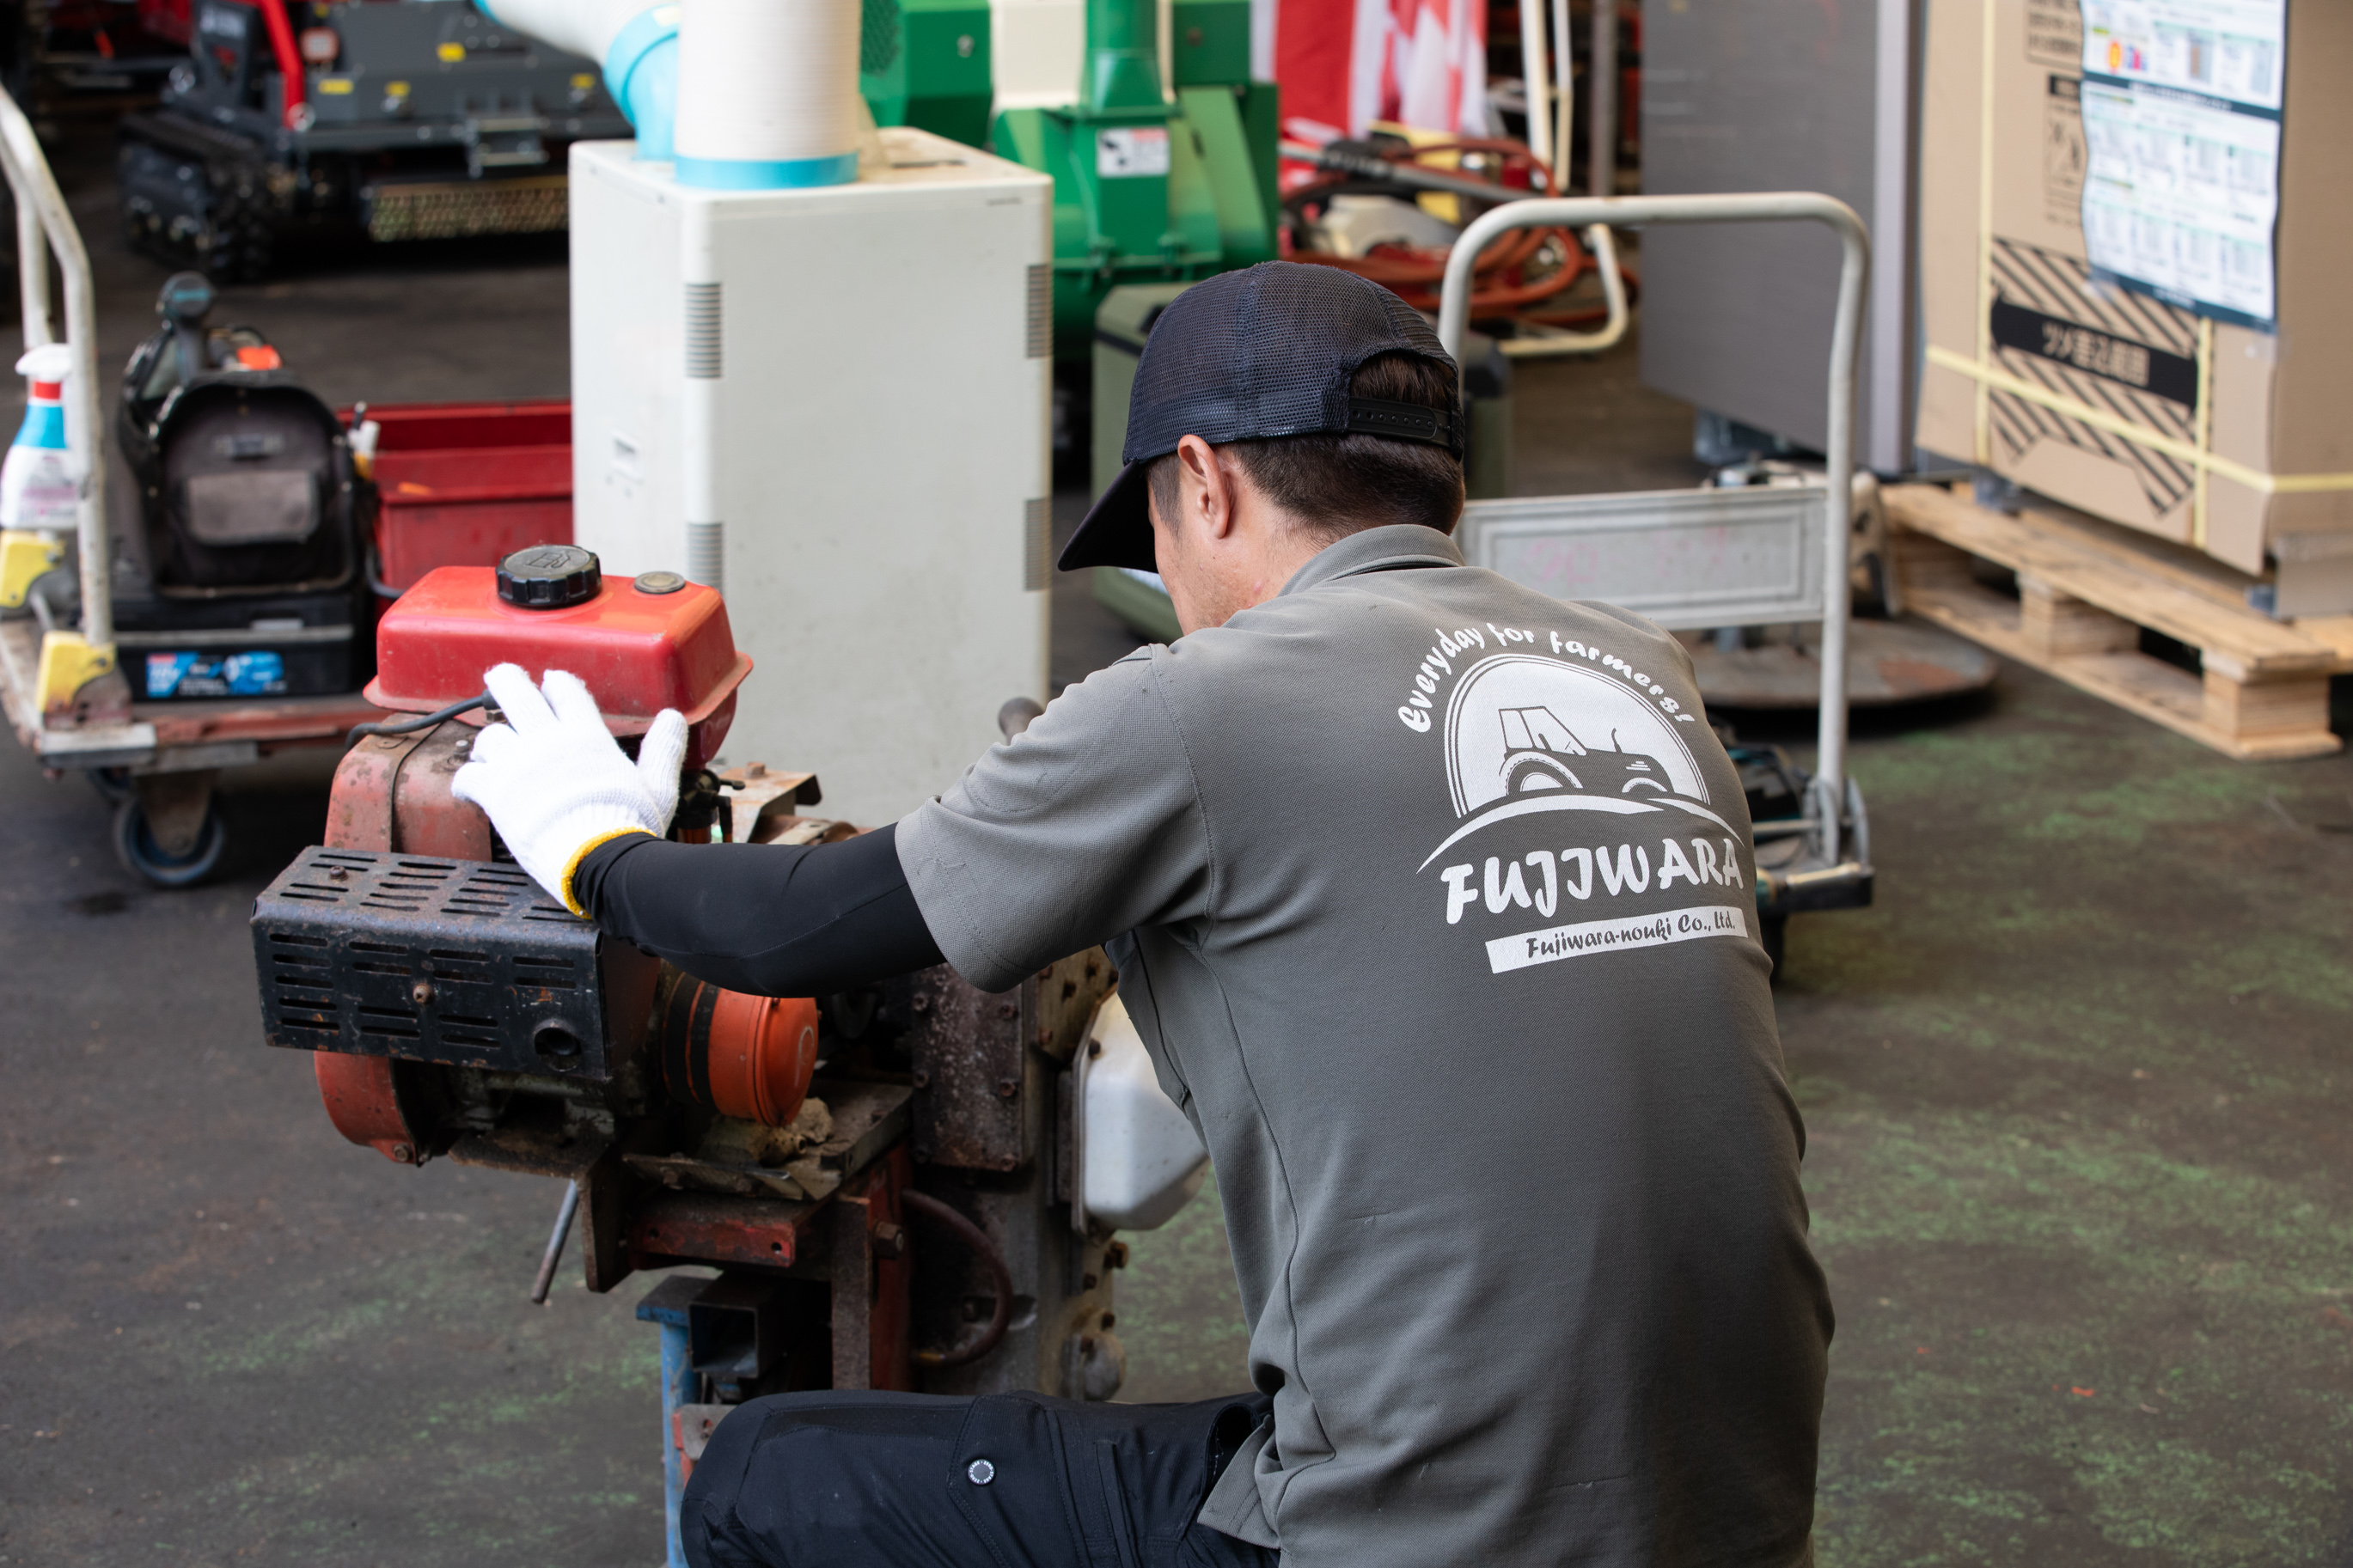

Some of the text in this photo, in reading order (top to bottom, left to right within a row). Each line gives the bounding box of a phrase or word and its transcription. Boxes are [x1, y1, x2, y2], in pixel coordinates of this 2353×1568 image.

[1398, 623, 1695, 732] Everyday for farmers!
[1440, 839, 1743, 924] FUJIWARA
[1526, 918, 1672, 958] Fujiwara-nouki
[1714, 911, 1735, 930] Ltd.
